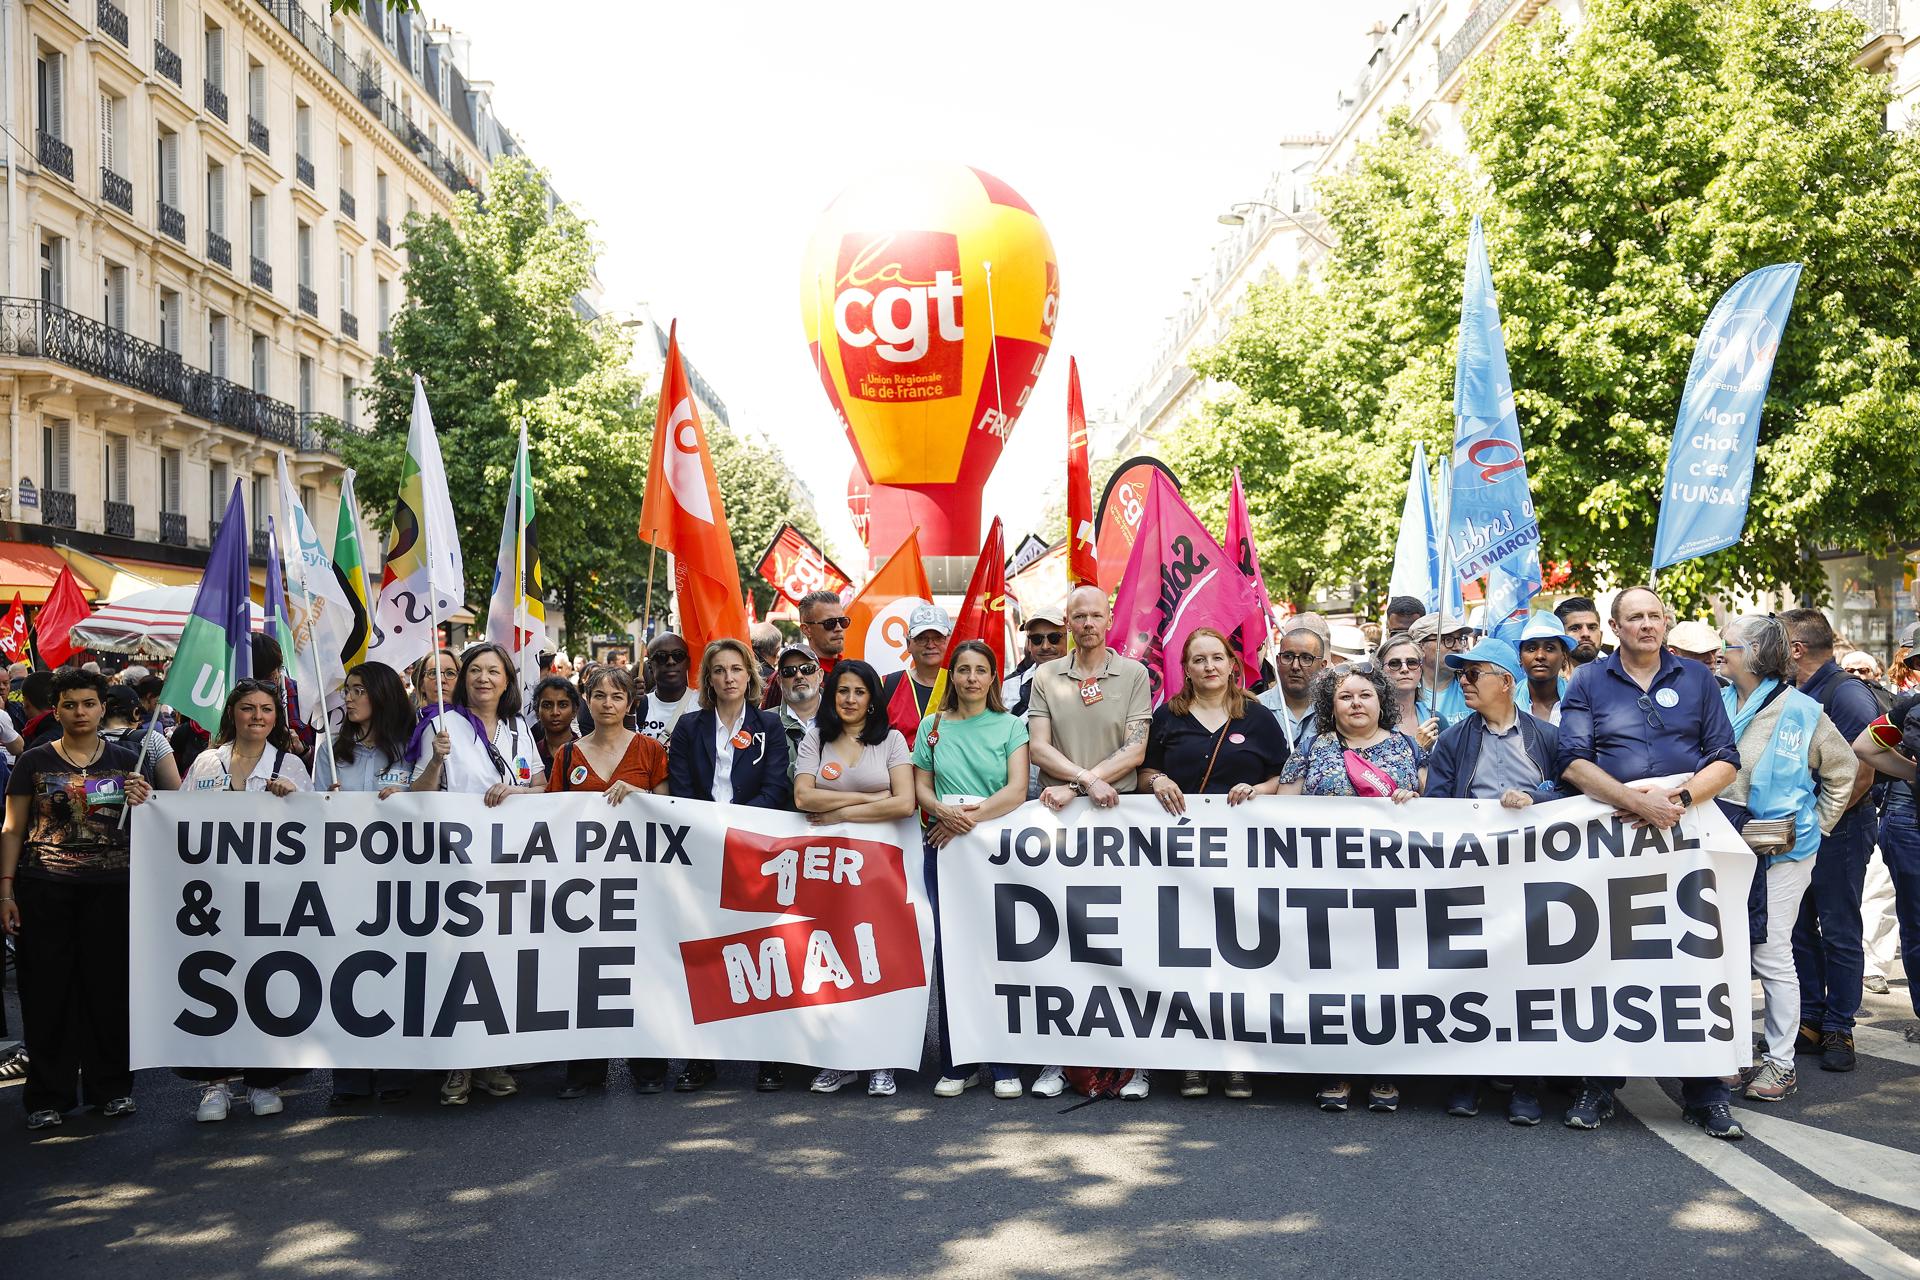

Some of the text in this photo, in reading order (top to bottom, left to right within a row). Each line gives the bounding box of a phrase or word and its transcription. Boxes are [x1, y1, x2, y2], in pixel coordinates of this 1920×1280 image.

[834, 270, 964, 362] cgt
[867, 373, 893, 385] Union
[1700, 406, 1746, 426] Mon
[1671, 482, 1736, 505] l'UNSA
[1459, 522, 1539, 581] LA MARQU
[1080, 682, 1102, 698] cgt
[926, 734, 939, 745] cgt
[177, 820, 693, 867] UNIS POUR LA PAIX
[988, 814, 1702, 869] JOURNÉE INTERNATIONAL
[760, 846, 865, 907] 1ER
[175, 878, 639, 938] & LA JUSTICE
[994, 868, 1725, 971] DE LUTTE DES
[721, 921, 883, 1004] MAI
[172, 946, 637, 1039] SOCIALE
[994, 982, 1736, 1046] TRAVAILLEURS.EUSES
